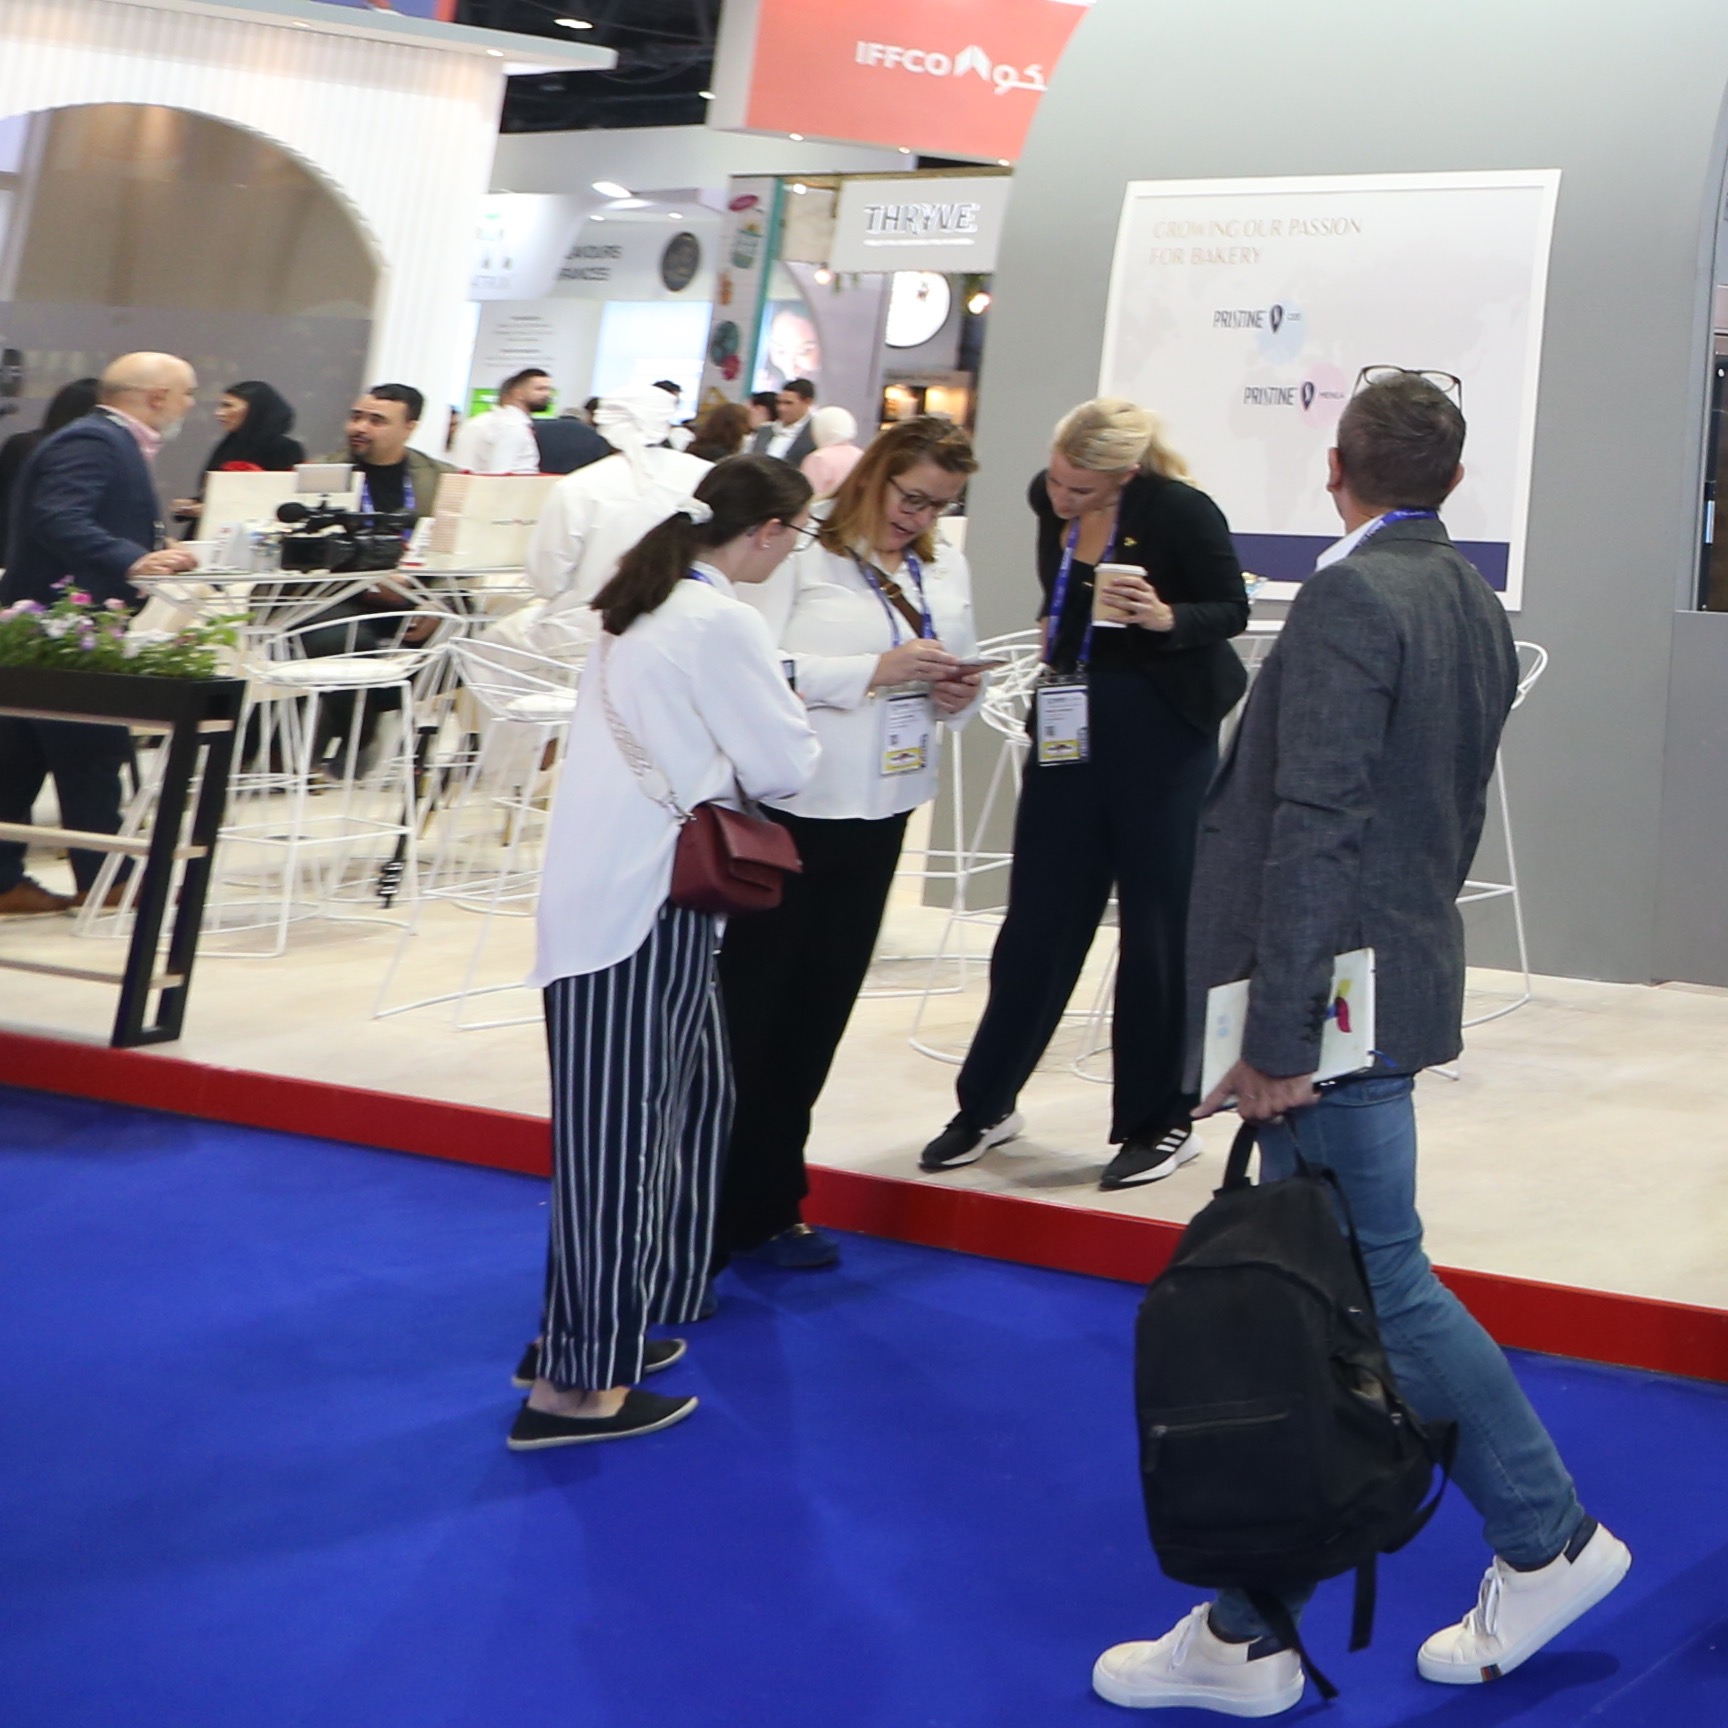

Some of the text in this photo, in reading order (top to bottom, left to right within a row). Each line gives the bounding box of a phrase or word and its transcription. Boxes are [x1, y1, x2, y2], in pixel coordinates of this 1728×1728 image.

[854, 40, 952, 77] IFFCO
[862, 203, 980, 234] THRYVE
[1152, 217, 1363, 239] GROWING OUR PASSION
[1149, 246, 1261, 265] FOR BAKERY
[1212, 310, 1266, 328] PRISTINE
[1243, 386, 1297, 405] PRISTINE
